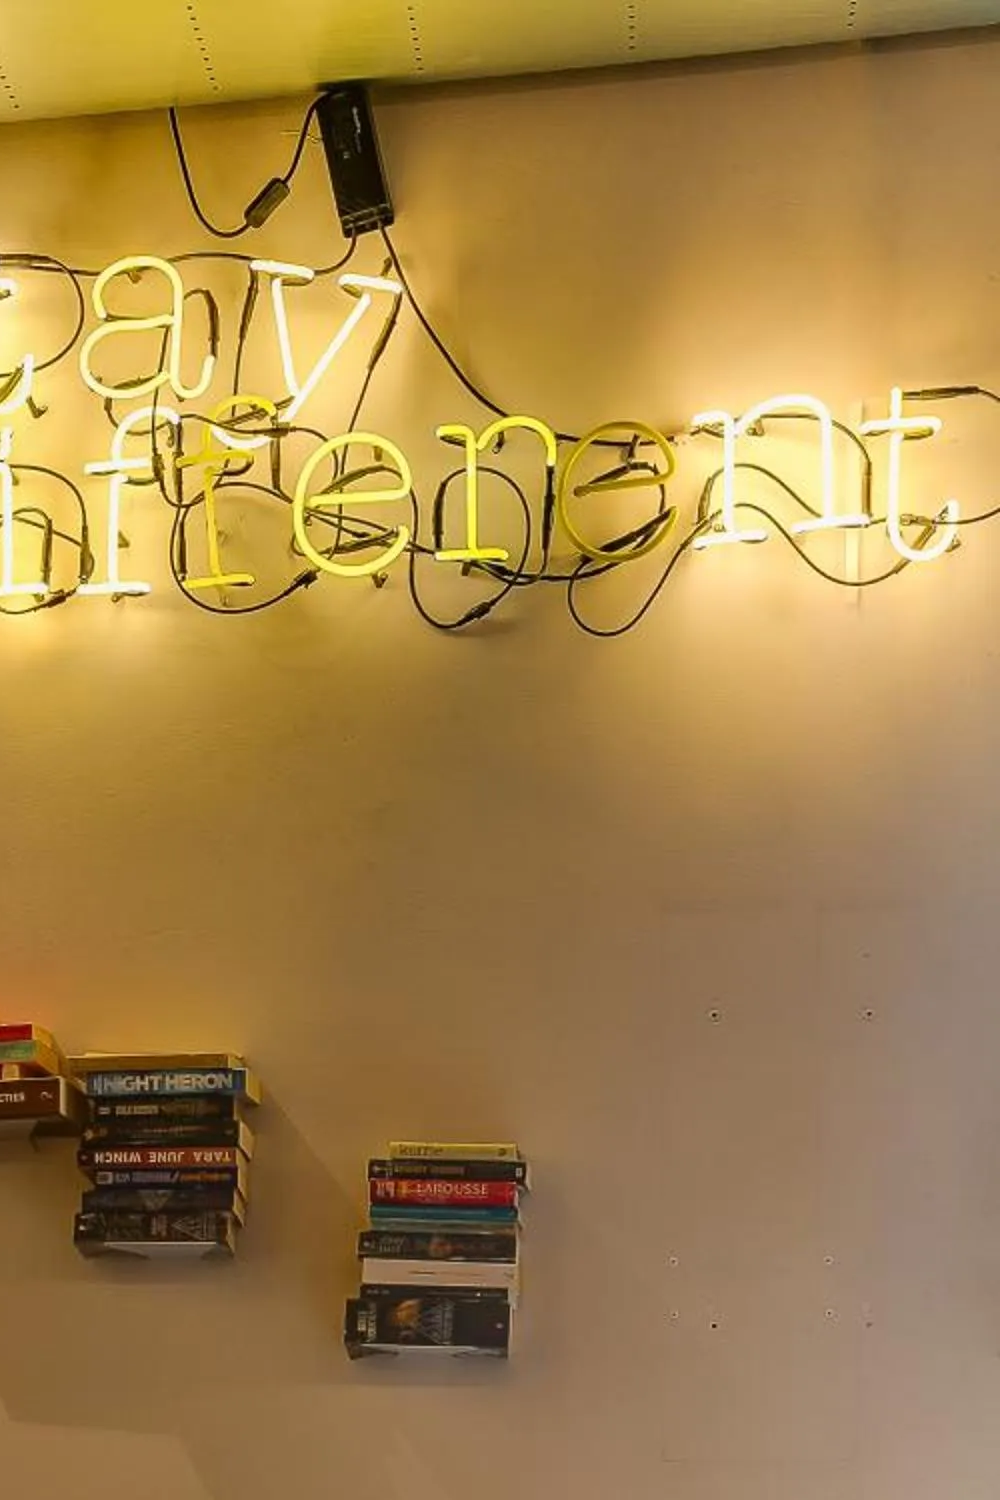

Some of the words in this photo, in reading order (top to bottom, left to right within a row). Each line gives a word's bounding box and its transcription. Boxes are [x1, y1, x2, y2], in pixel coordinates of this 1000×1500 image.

[103, 1073, 162, 1091] NIGHT
[165, 1073, 233, 1090] HERON
[94, 1151, 142, 1164] WINCH
[148, 1151, 186, 1163] JUNE
[194, 1151, 232, 1163] TARA
[416, 1183, 489, 1197] LAROUSSE
